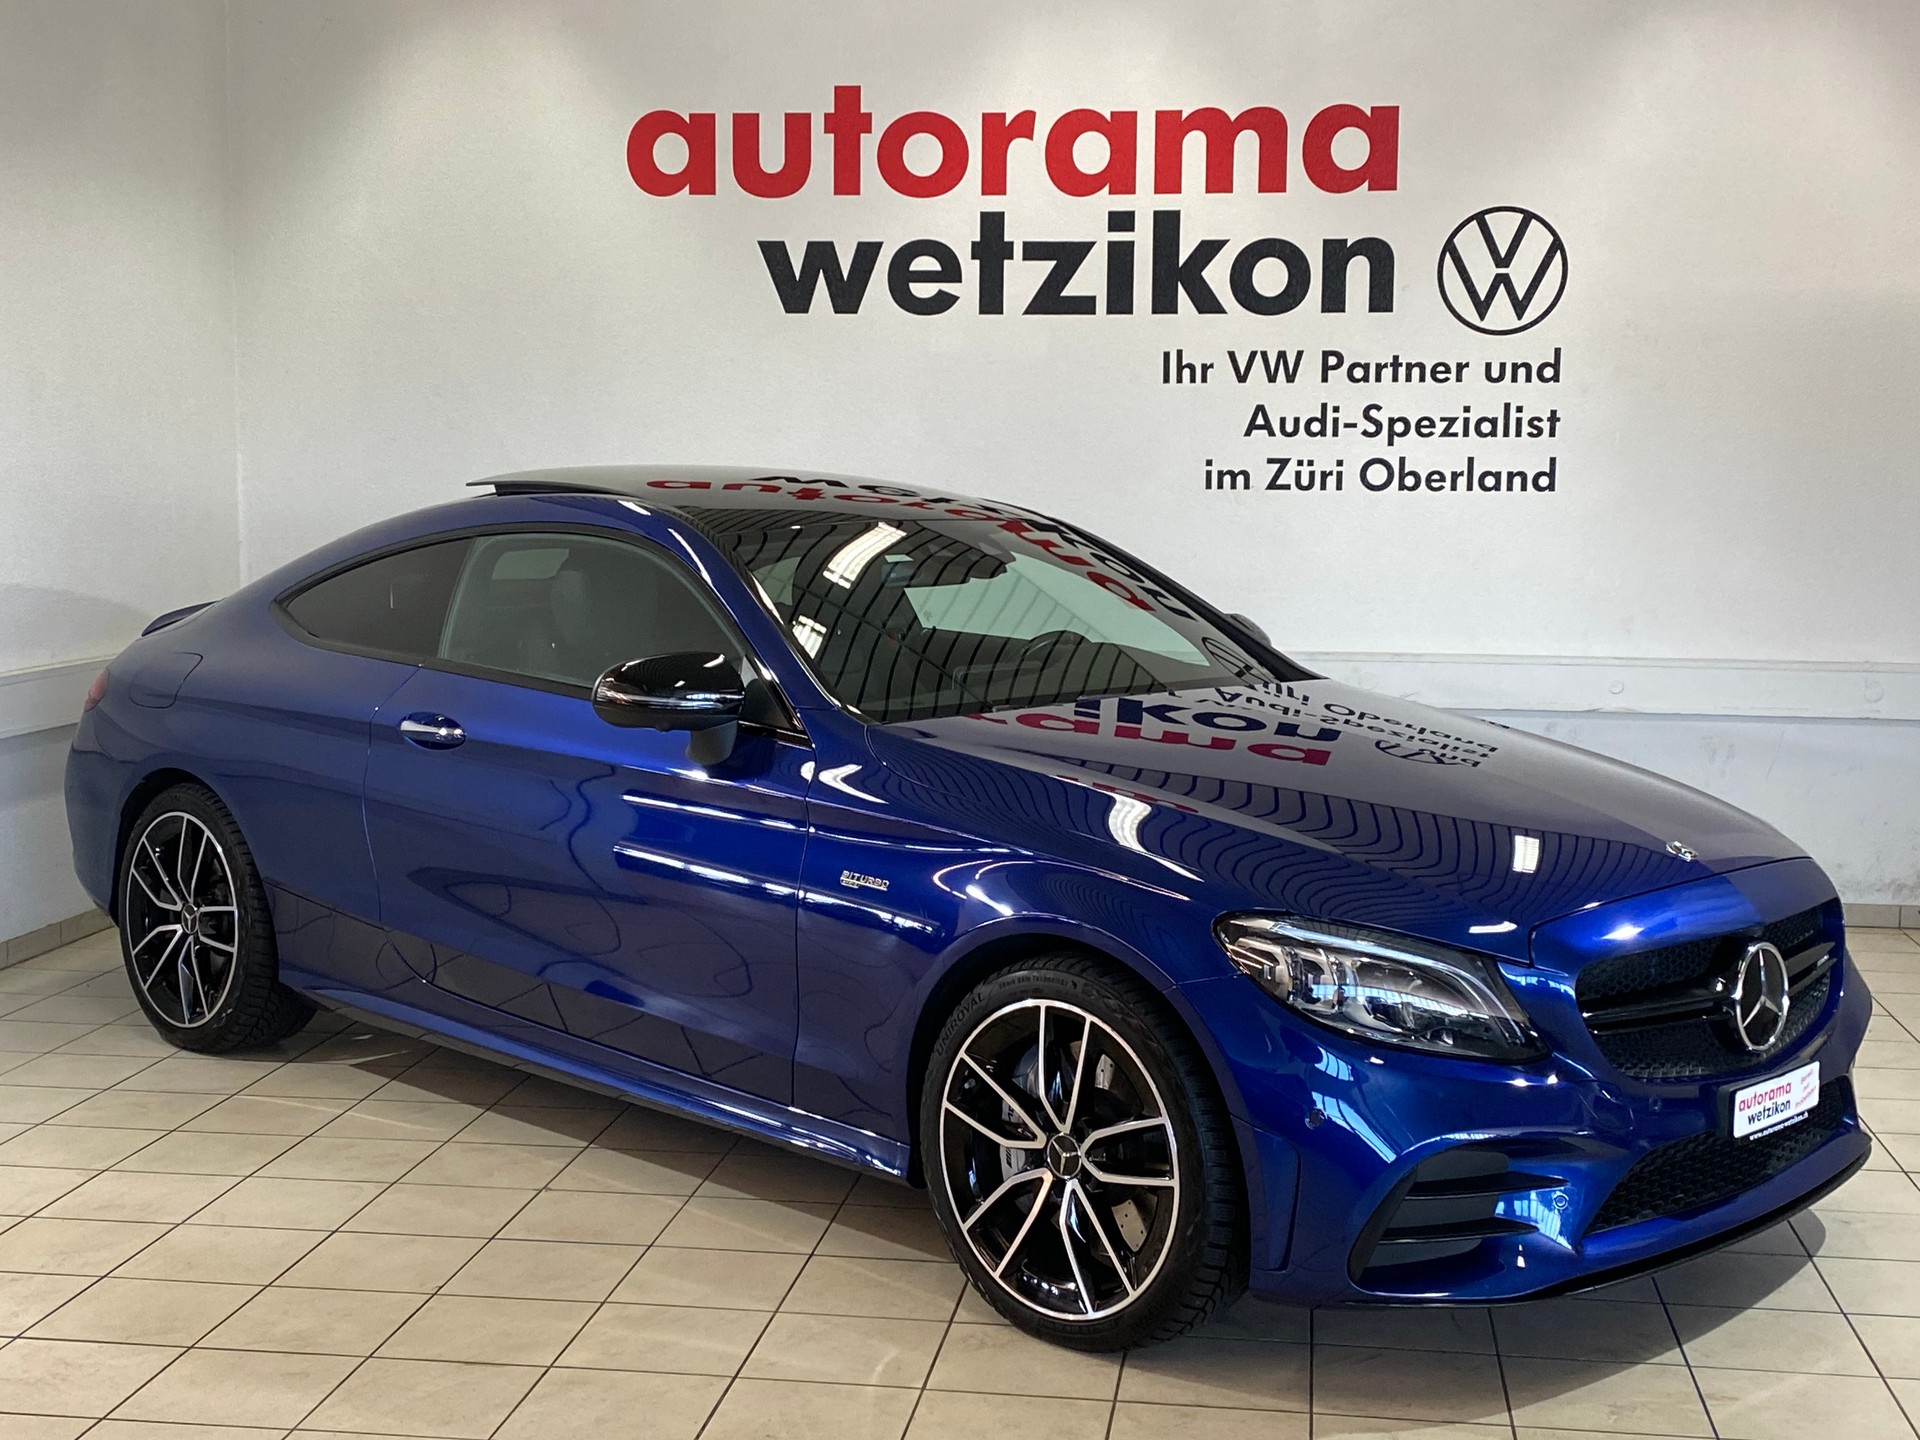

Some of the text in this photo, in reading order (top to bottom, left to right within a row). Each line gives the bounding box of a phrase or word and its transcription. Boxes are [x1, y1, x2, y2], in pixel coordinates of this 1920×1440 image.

[627, 85, 1399, 198] autorama
[758, 210, 1394, 315] wetzikon
[1163, 348, 1561, 383] Ihr VW Partner und
[1244, 403, 1560, 446] Audi-Spezialist
[1206, 457, 1556, 492] im Züri Oberland
[935, 992, 985, 1057] UNIROYAL
[1738, 1082, 1792, 1112] autorama
[1747, 1099, 1791, 1125] wetzikon
